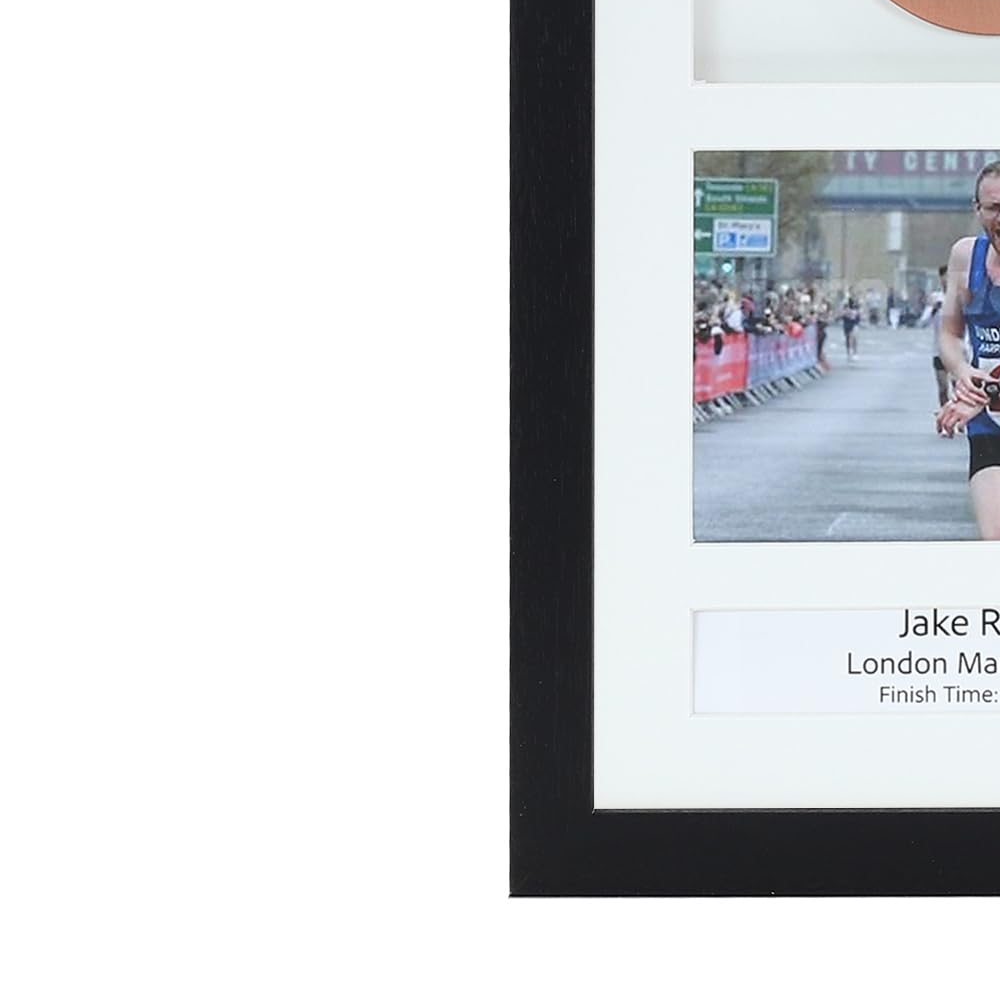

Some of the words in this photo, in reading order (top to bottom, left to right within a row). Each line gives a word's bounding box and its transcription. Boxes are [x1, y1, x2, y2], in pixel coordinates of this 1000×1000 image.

[899, 608, 969, 638] Jake
[848, 650, 947, 675] London
[879, 685, 936, 703] Finish
[943, 685, 998, 703] Time:
